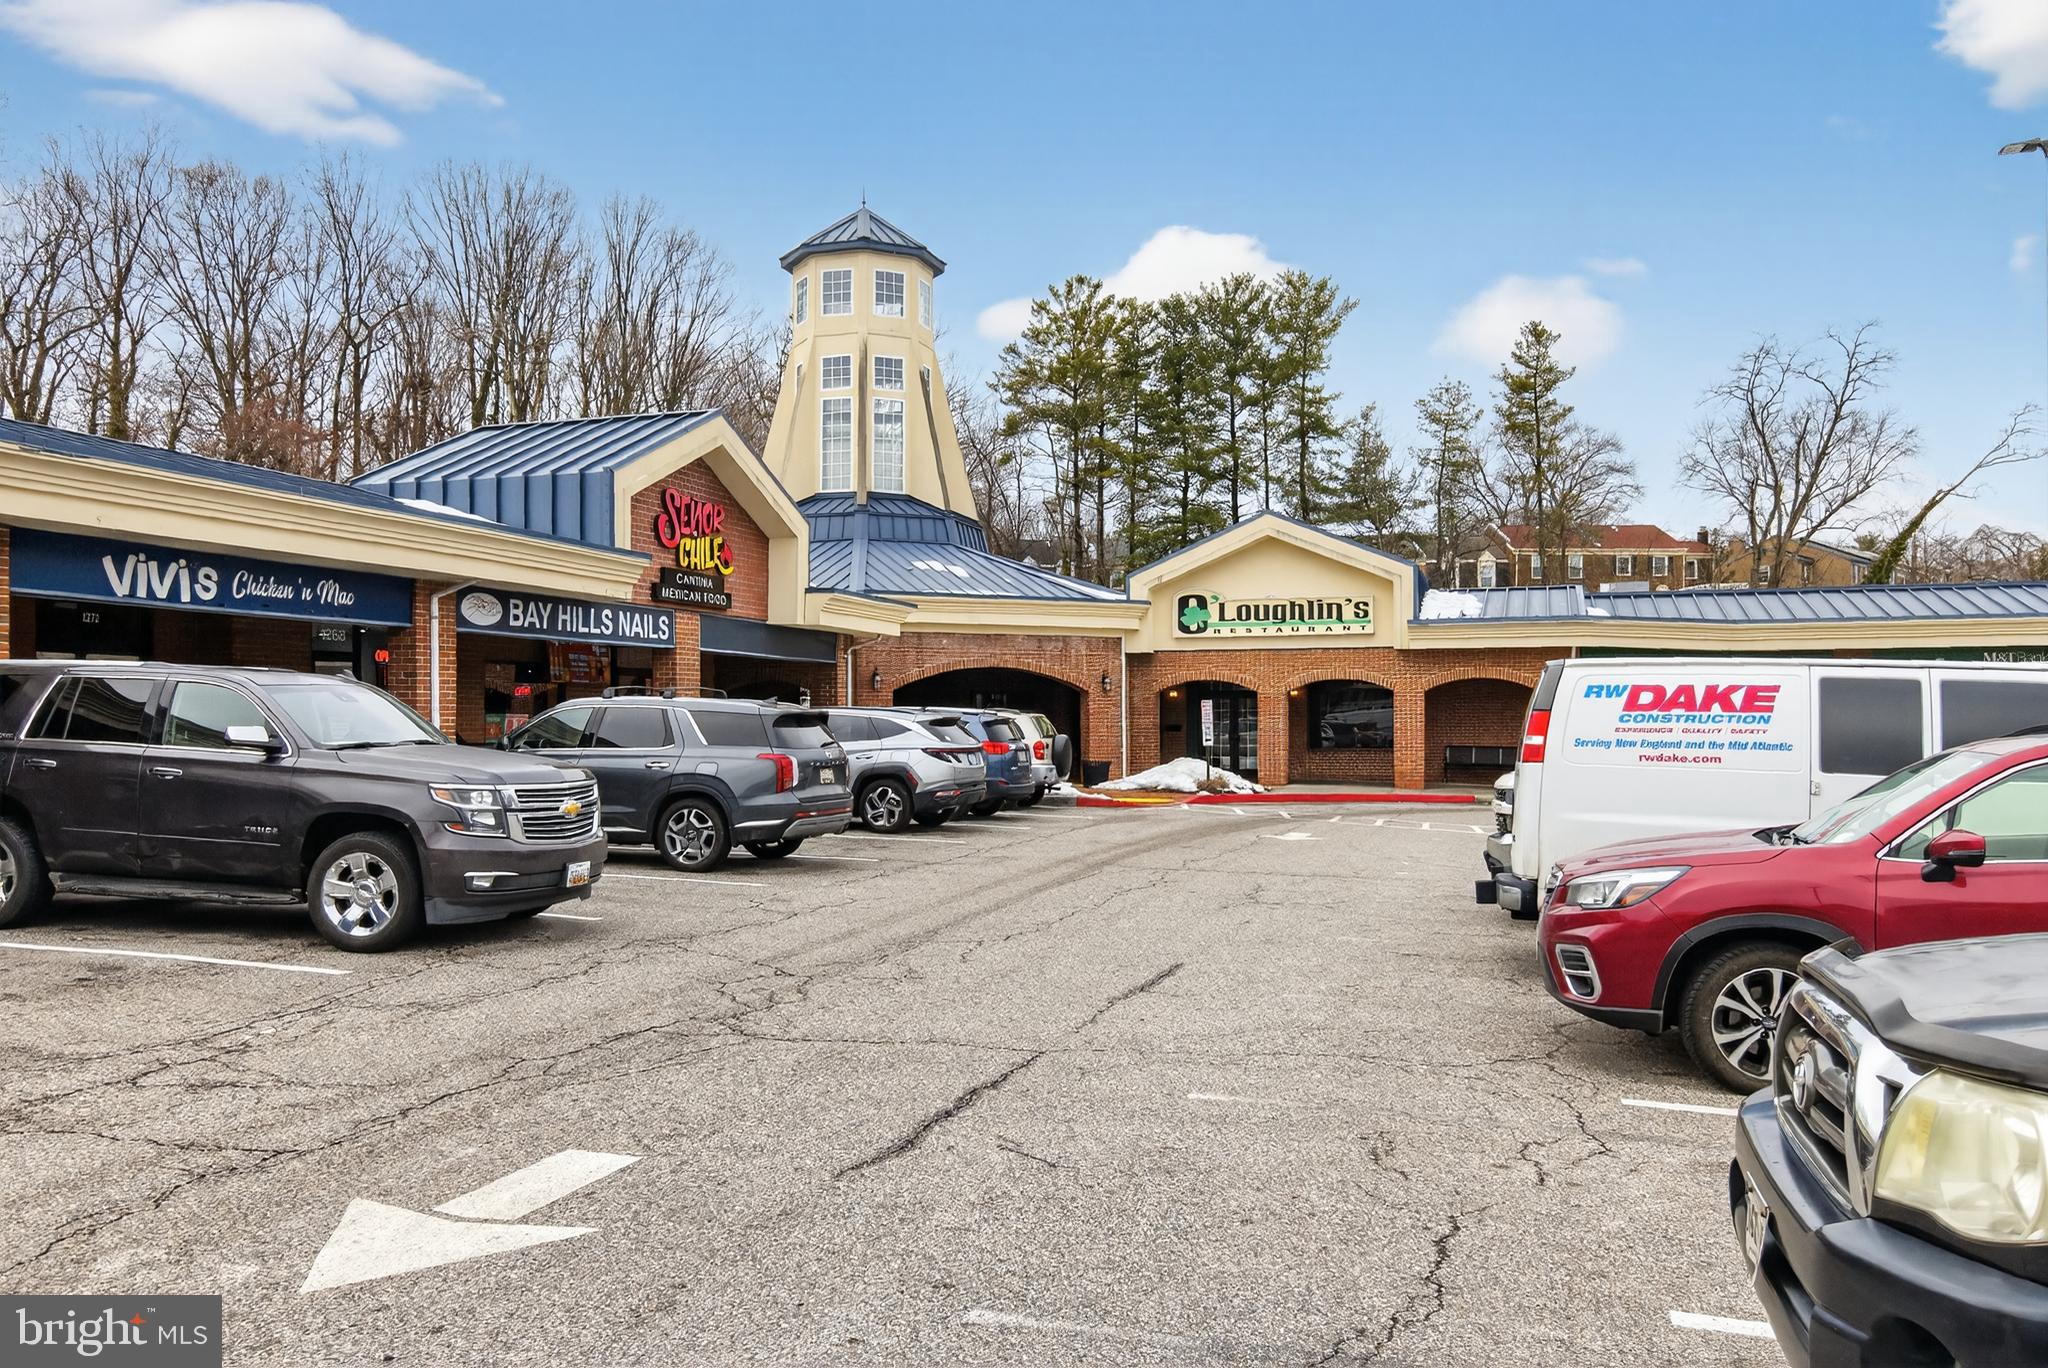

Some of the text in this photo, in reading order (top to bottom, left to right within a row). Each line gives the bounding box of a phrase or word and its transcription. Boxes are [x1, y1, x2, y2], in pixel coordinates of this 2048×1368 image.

[679, 536, 735, 575] CHILE
[232, 570, 294, 599] Chicken
[316, 579, 355, 606] Mac
[676, 573, 713, 589] CANTINA
[662, 587, 727, 605] MEXICAN FOOD
[509, 599, 670, 640] BAY HILLS NAILS
[1213, 624, 1368, 635] RESTAURANT
[1583, 684, 1781, 713] RW DAKE
[1618, 713, 1772, 725] CONSTRUCTION
[1574, 738, 1794, 752] Serving New England and the Mid Atlantic
[1638, 753, 1722, 764] rwdake.com
